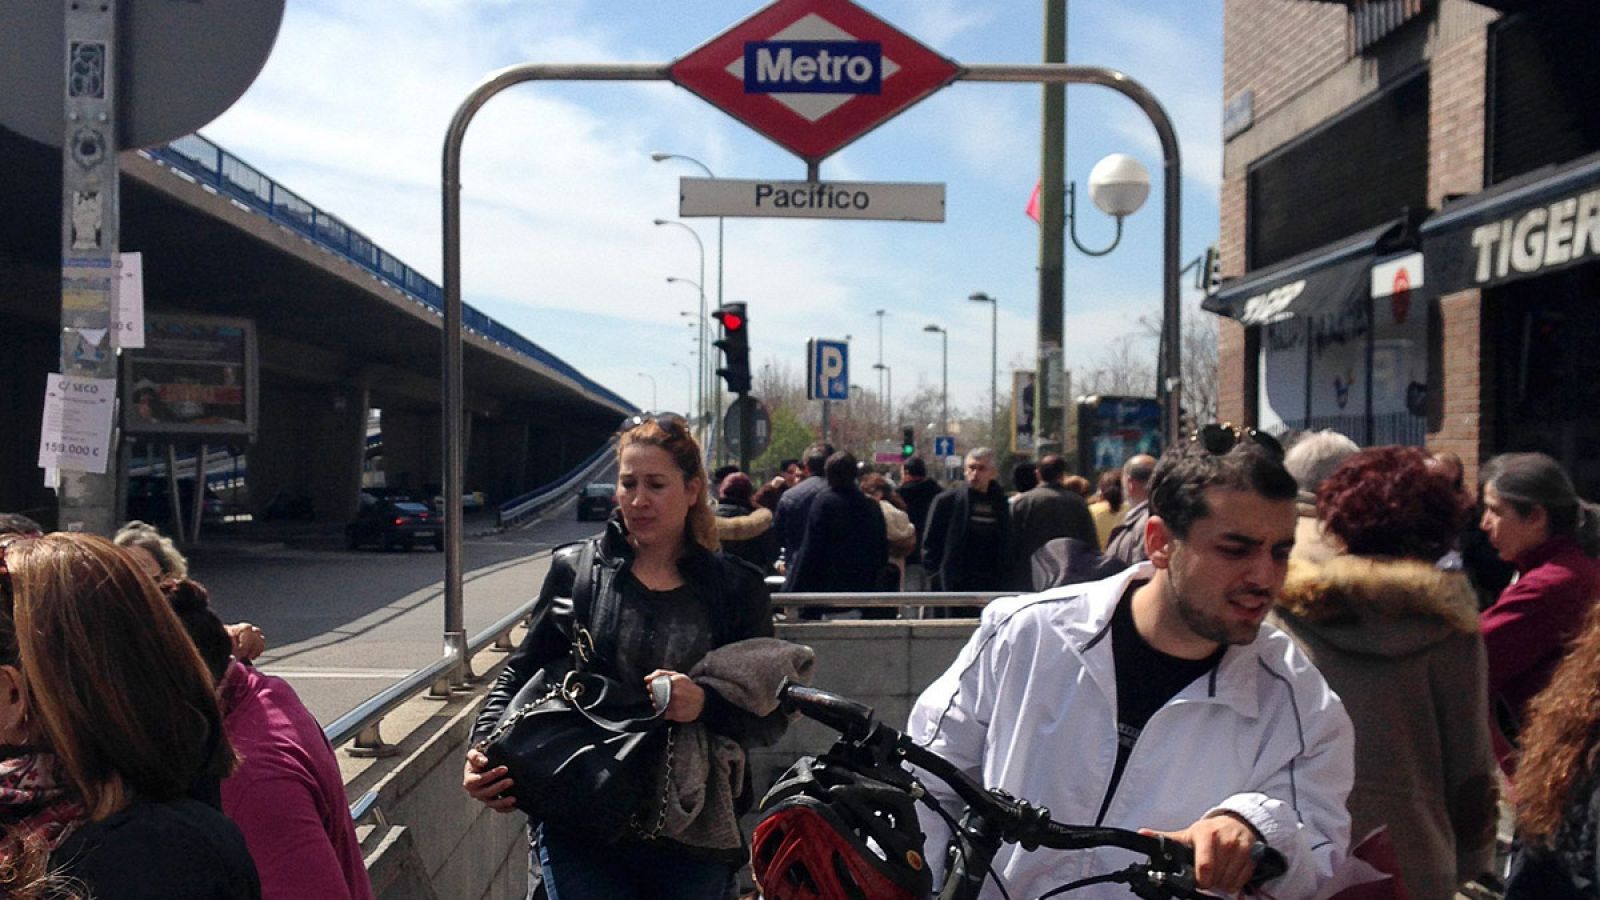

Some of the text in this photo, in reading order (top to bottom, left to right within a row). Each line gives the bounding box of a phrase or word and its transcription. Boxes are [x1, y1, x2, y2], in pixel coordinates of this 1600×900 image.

[756, 48, 873, 83] Metro
[755, 184, 870, 210] Pacífico
[1472, 190, 1600, 283] TIGER
[58, 380, 99, 394] C/ SECO
[820, 346, 843, 397] P
